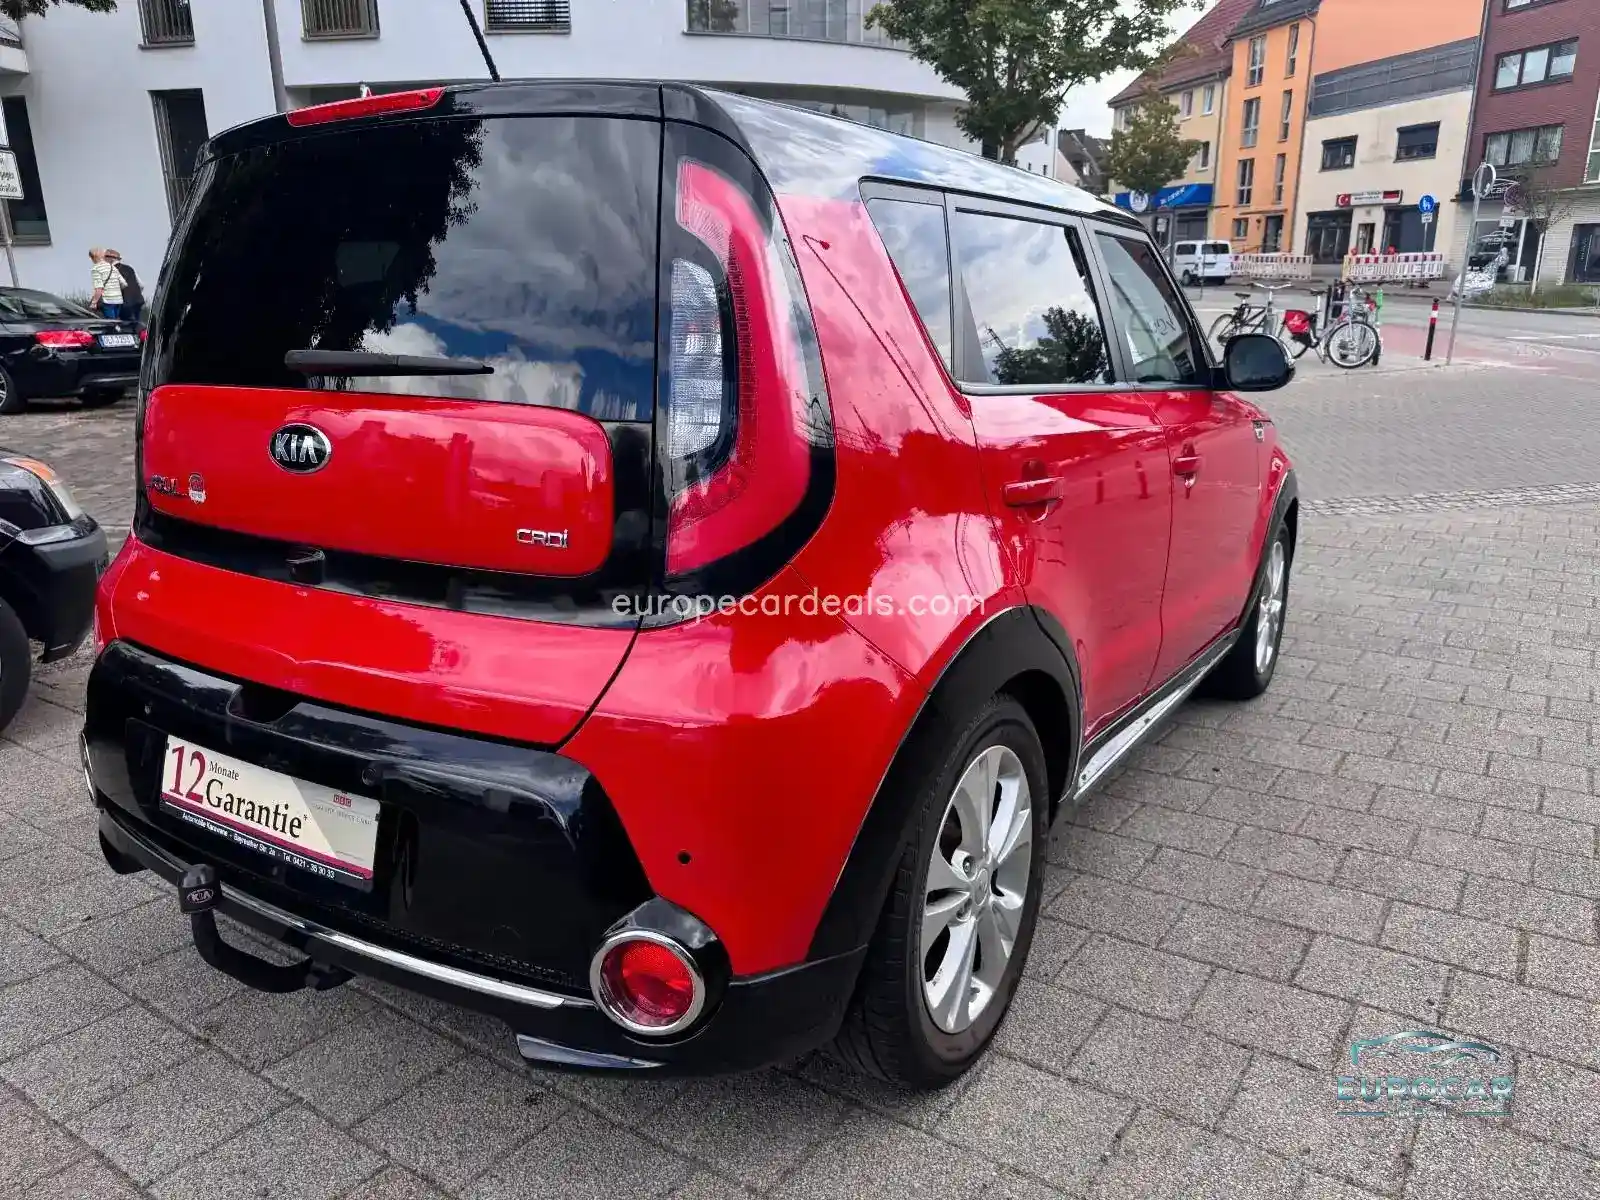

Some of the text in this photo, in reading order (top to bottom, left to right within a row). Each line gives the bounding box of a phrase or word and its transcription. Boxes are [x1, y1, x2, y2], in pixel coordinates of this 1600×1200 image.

[275, 433, 319, 464] KIA
[516, 528, 568, 549] CRDi
[169, 745, 206, 804] 12
[208, 760, 240, 781] Monate
[293, 856, 306, 868] 0421
